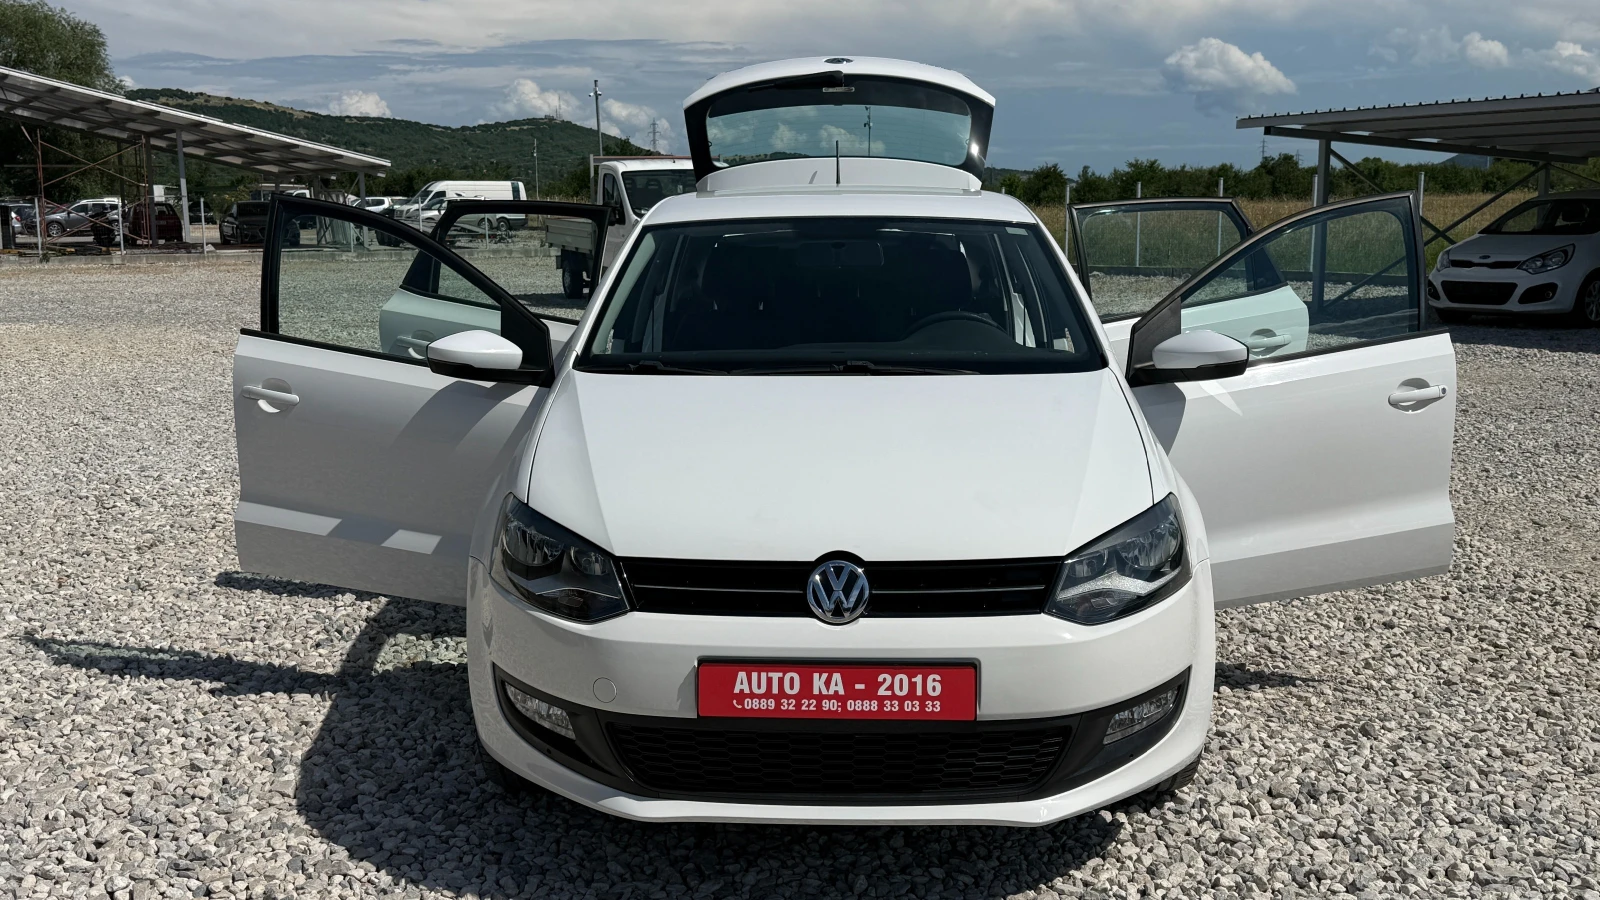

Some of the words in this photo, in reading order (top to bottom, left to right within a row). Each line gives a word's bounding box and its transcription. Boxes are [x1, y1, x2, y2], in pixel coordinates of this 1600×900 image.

[733, 671, 801, 695] AUTO
[812, 672, 845, 696] KA
[876, 673, 942, 697] 2016
[744, 698, 776, 710] 0889
[780, 699, 796, 711] 32
[801, 699, 817, 711] 22
[821, 699, 842, 713] 90;
[846, 700, 878, 712] 0888
[883, 700, 899, 712] 33
[903, 700, 920, 712] 03
[924, 701, 941, 713] 33
